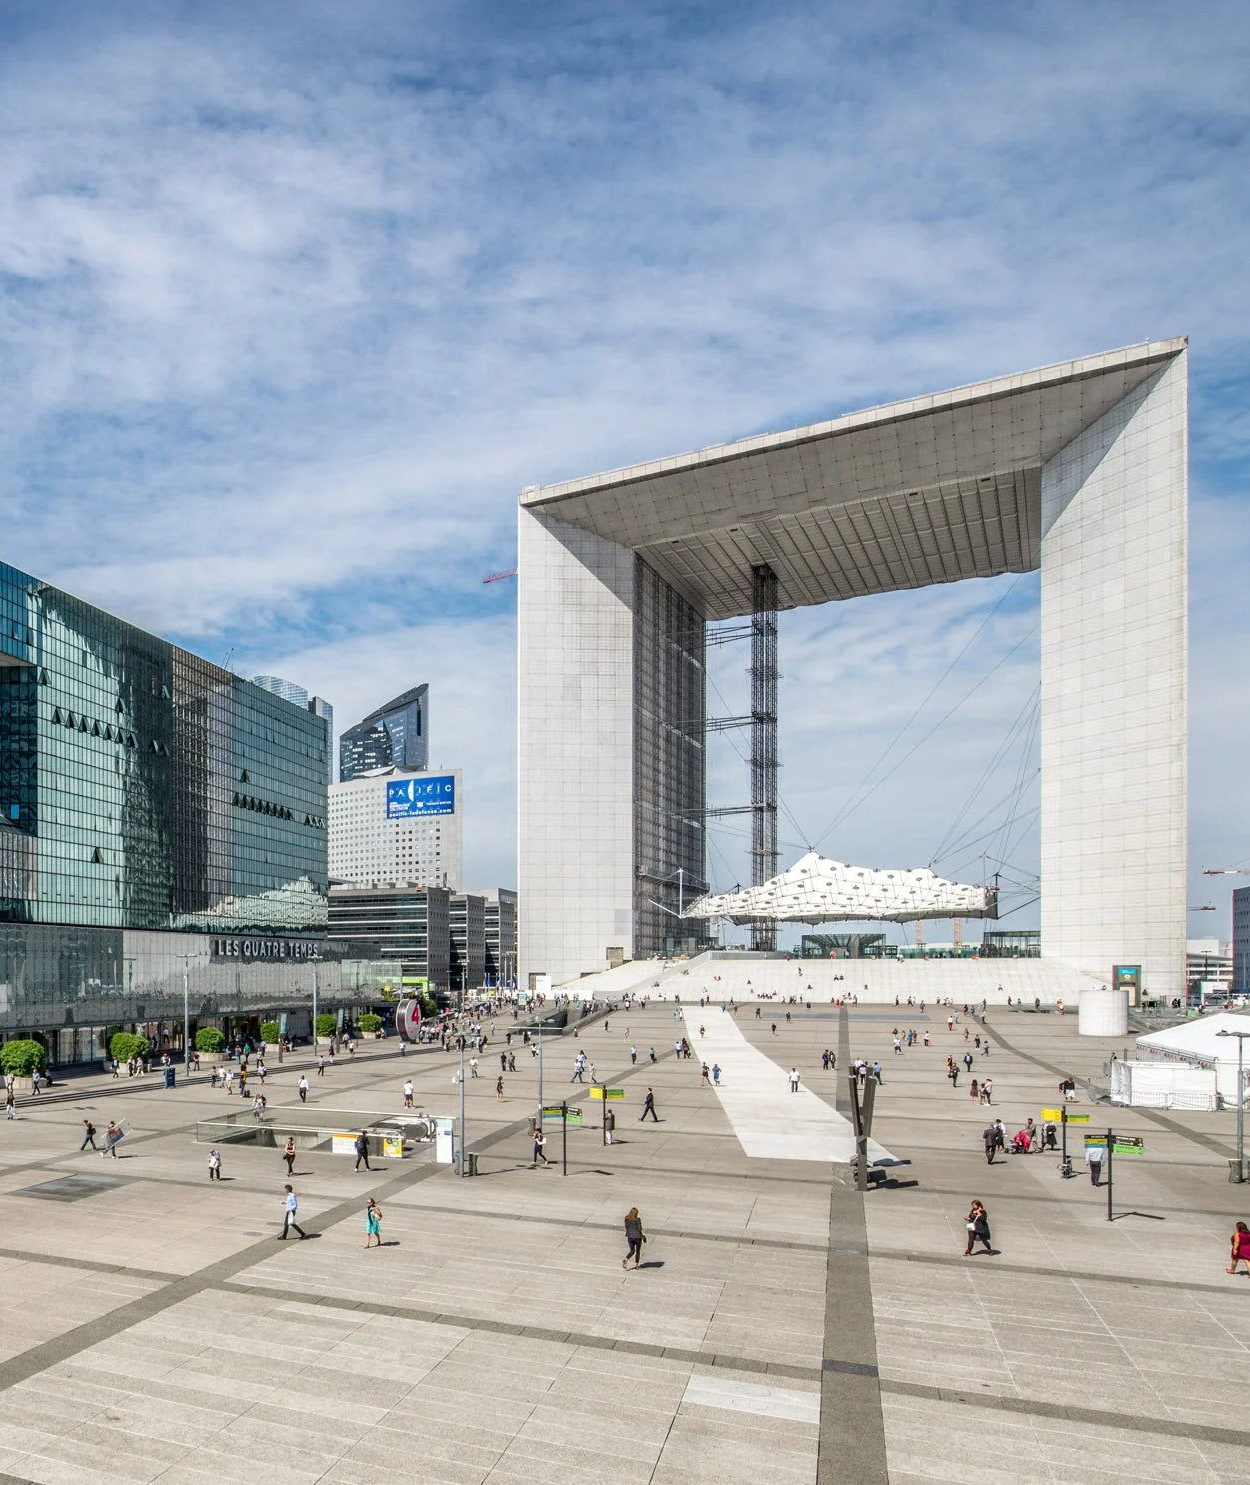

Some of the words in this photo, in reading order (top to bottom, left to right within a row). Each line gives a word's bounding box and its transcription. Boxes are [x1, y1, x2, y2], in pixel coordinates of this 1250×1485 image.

[218, 939, 239, 956] LES
[243, 940, 285, 957] QUATRE
[289, 942, 318, 958] TEMPS
[411, 1004, 419, 1025] 4
